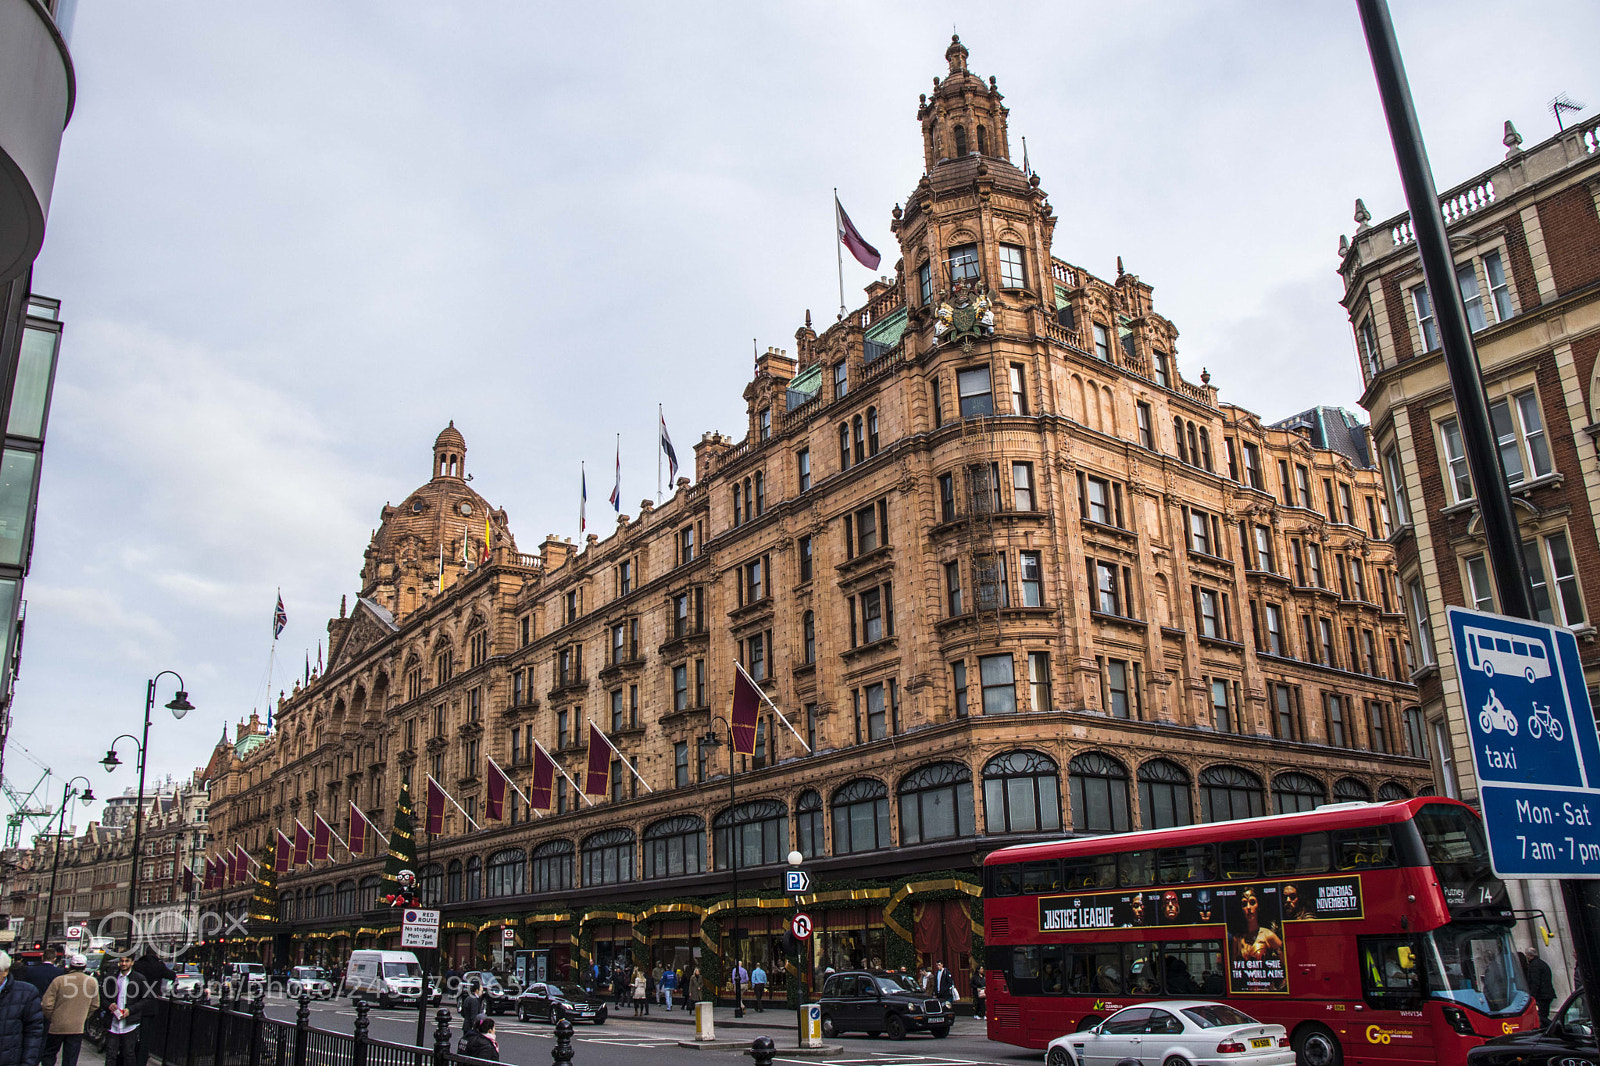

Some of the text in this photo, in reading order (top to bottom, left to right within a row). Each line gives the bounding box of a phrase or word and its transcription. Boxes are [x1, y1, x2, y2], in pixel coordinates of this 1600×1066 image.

[1485, 744, 1517, 770] taxi
[1318, 885, 1353, 898] IN CINEMAS
[1443, 886, 1493, 904] Putney 74
[1316, 896, 1357, 909] NOVEMBER 17
[1044, 907, 1114, 929] JUSTICE LEAGUE
[1232, 970, 1242, 978] THE
[1244, 970, 1266, 978] WORLD
